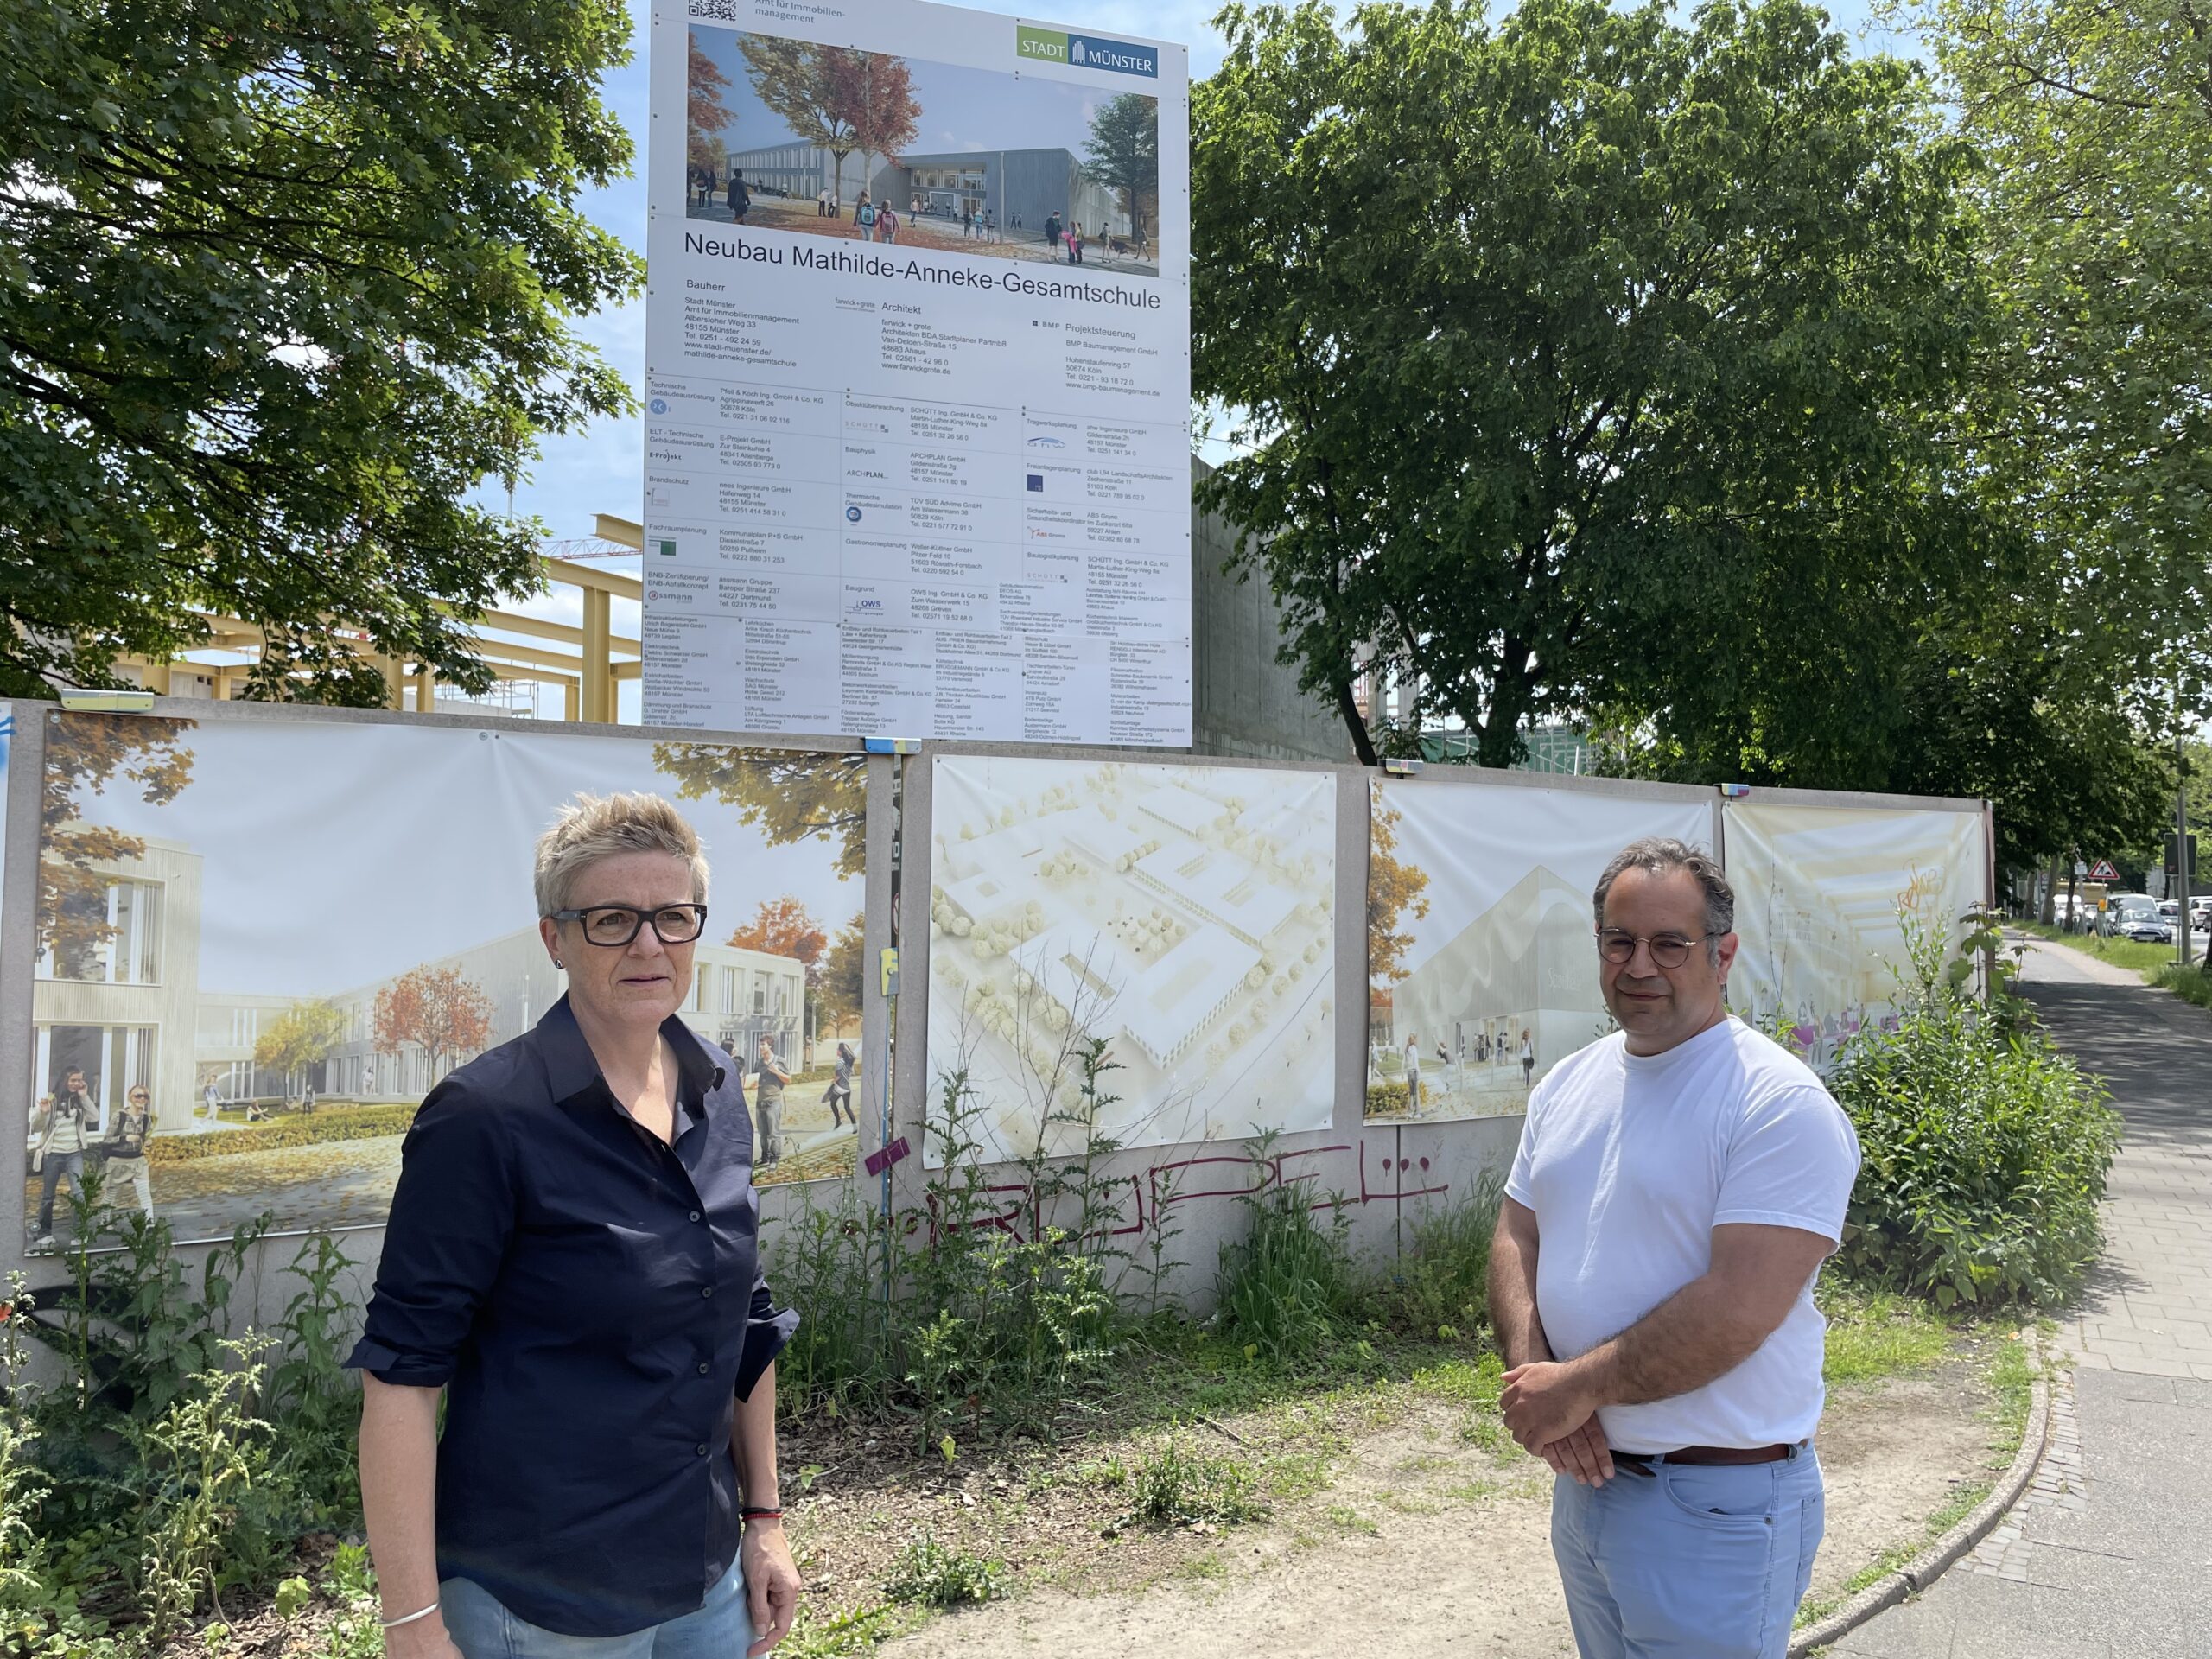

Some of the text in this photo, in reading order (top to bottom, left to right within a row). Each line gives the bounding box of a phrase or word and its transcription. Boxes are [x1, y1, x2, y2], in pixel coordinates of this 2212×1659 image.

[776, 0, 788, 9] für
[791, 2, 846, 17] Immobilien-
[755, 9, 814, 23] management
[1023, 40, 1153, 73] STADT MÜNSTER
[685, 232, 1161, 309] Neubau Mathilde-Anneke-Gesamtschule
[687, 279, 726, 292] Bauherr
[684, 296, 735, 308] Stadt Münster
[881, 302, 921, 315] Architekt
[684, 314, 726, 325] Albersloher
[728, 318, 745, 328] Weg
[713, 308, 799, 324] Immobilienmanagement
[881, 318, 906, 327] farwick
[684, 322, 740, 334] 48155 Münster
[1065, 323, 1135, 341] Projektsteuerung
[684, 331, 698, 340] Tel.
[700, 333, 718, 341] 0251
[881, 327, 919, 338] Architekten
[921, 331, 937, 340] BDA
[938, 334, 976, 344] Stadtplaner
[881, 335, 946, 349] Van-Delden-Straße
[905, 346, 926, 355] Ahaus
[1083, 341, 1136, 353] Baumanagement
[1137, 347, 1158, 356] GmbH
[684, 350, 797, 367] mathilde-anneke-gesamtschule
[896, 354, 917, 363] 02561
[881, 363, 950, 375] www.farwickgrote.de
[651, 381, 686, 391] Technische
[650, 389, 714, 403] Gebäudeausrüstung
[649, 475, 689, 485] Brandschutz
[649, 524, 707, 536] Fachraumplanung
[749, 578, 772, 587] Gruppe
